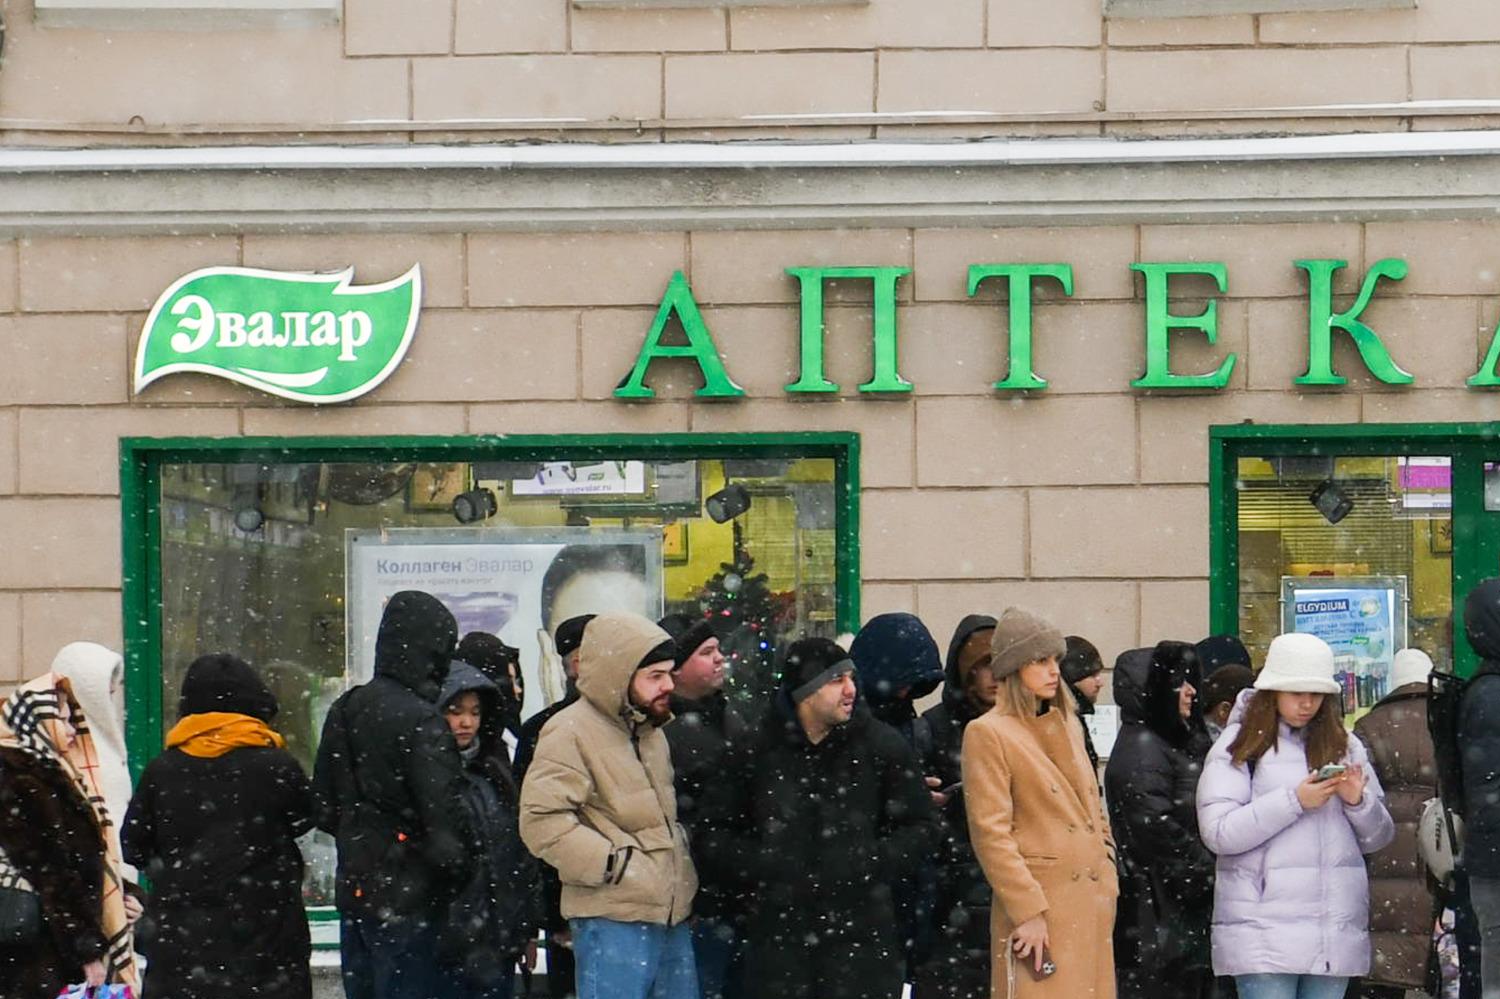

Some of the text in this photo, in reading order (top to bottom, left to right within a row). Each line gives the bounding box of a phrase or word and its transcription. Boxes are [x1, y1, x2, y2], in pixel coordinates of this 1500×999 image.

[169, 294, 373, 362] Эвалар
[376, 557, 534, 576] Коллаген Эвалар
[1296, 599, 1348, 613] ELGYDIUM
